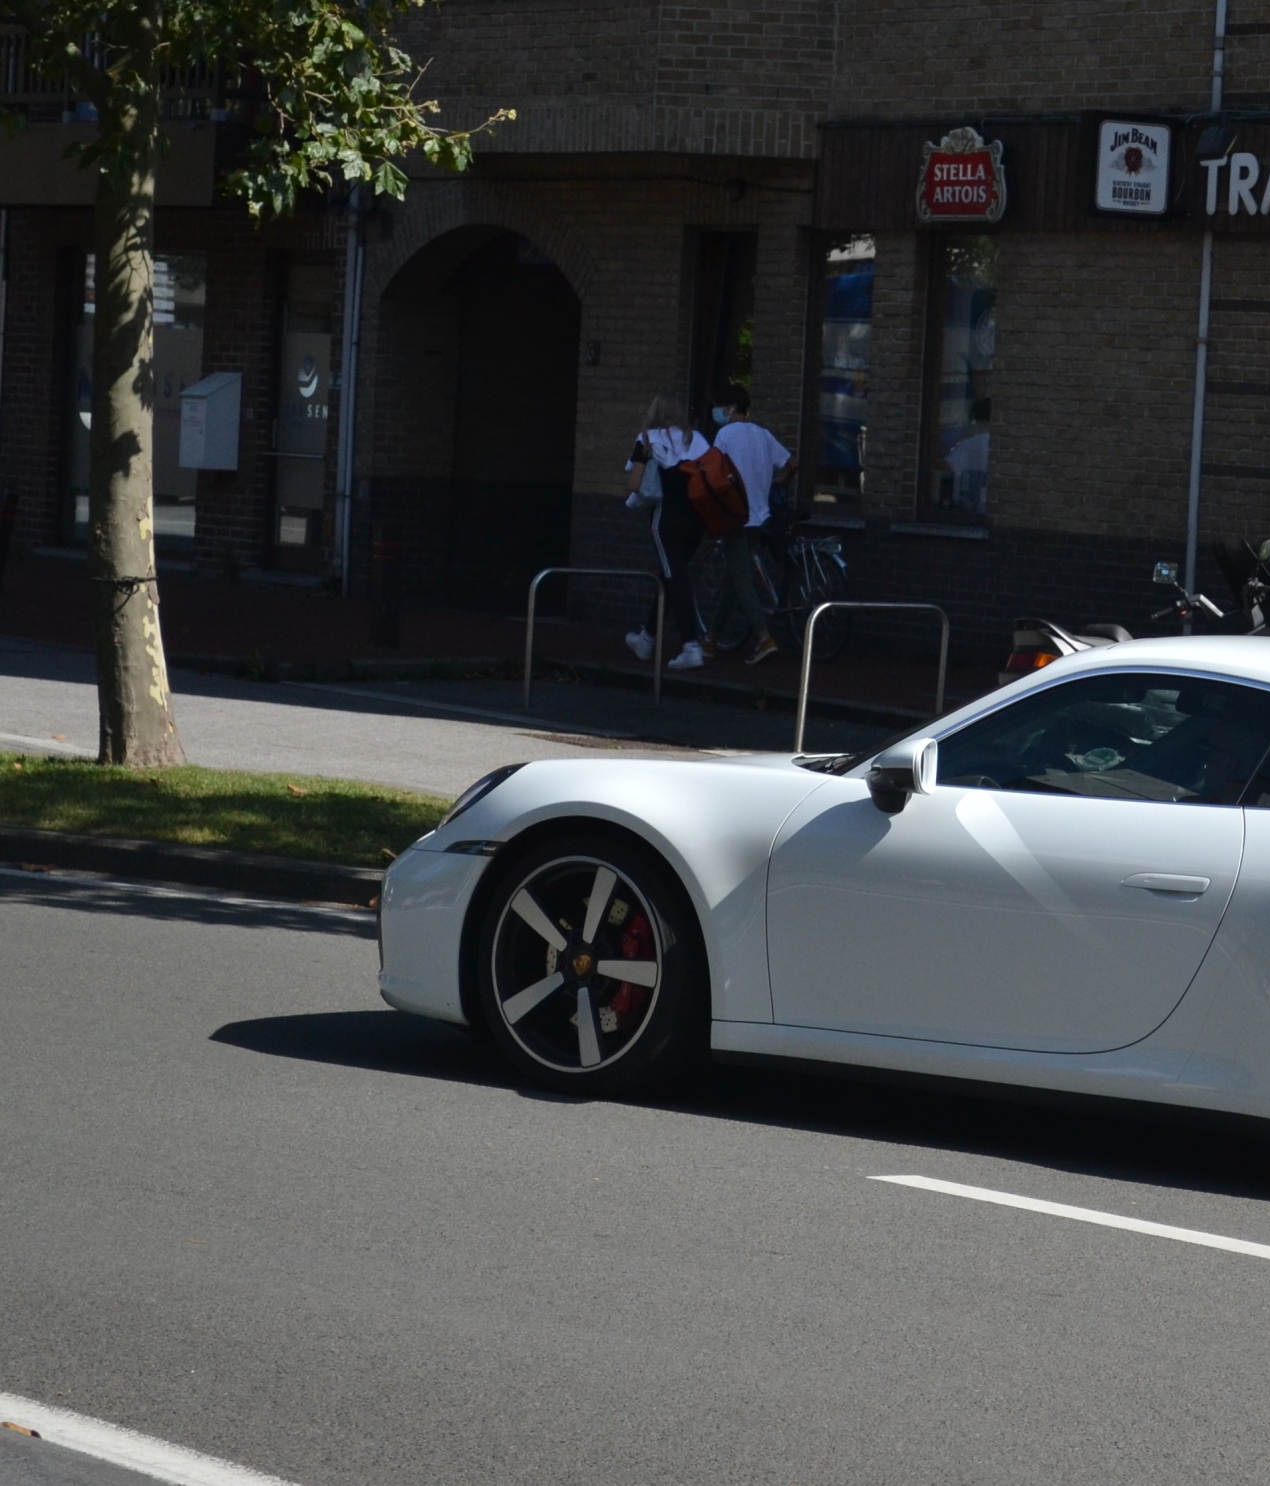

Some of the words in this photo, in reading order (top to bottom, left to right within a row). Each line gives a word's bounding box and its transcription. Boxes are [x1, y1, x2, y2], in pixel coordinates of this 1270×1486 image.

[1110, 131, 1130, 152] JIM
[1131, 128, 1157, 156] BEAM
[933, 163, 986, 181] STELLA
[933, 186, 987, 204] ARTOIS
[1112, 187, 1151, 201] BOURBON
